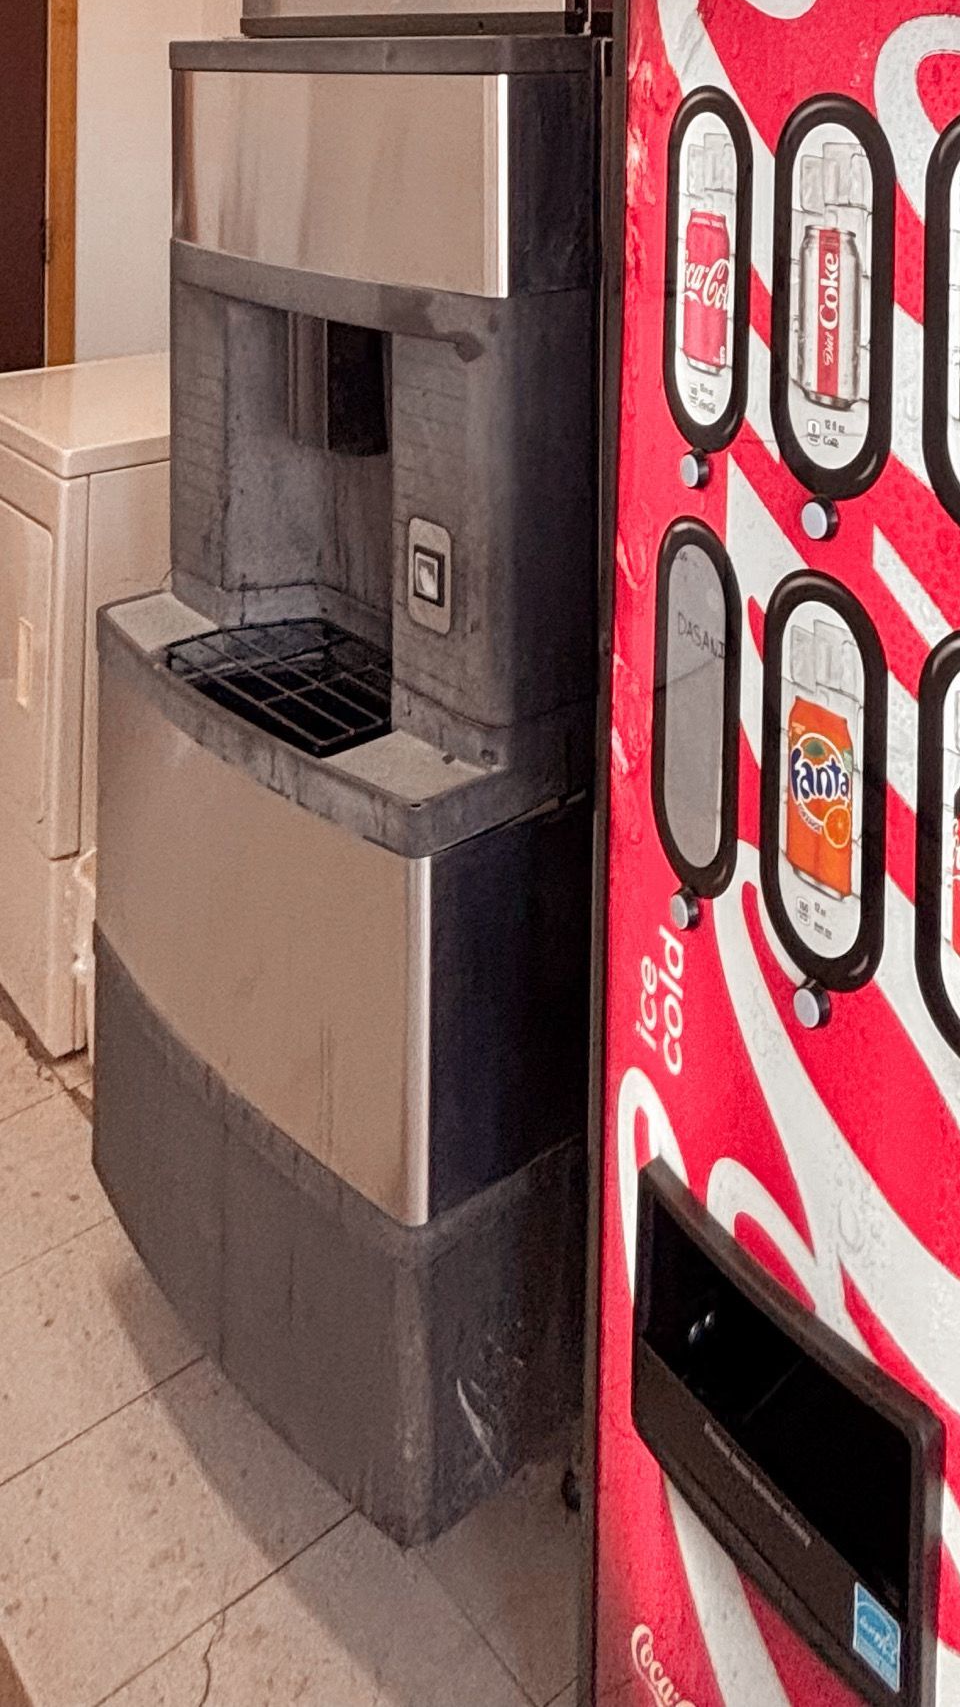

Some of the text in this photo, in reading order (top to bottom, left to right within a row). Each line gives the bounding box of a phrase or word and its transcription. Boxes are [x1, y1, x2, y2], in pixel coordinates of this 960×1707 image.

[819, 252, 839, 330] Coke
[678, 612, 726, 659] DASANI
[636, 955, 658, 1051] ice
[658, 924, 684, 1075] cold
